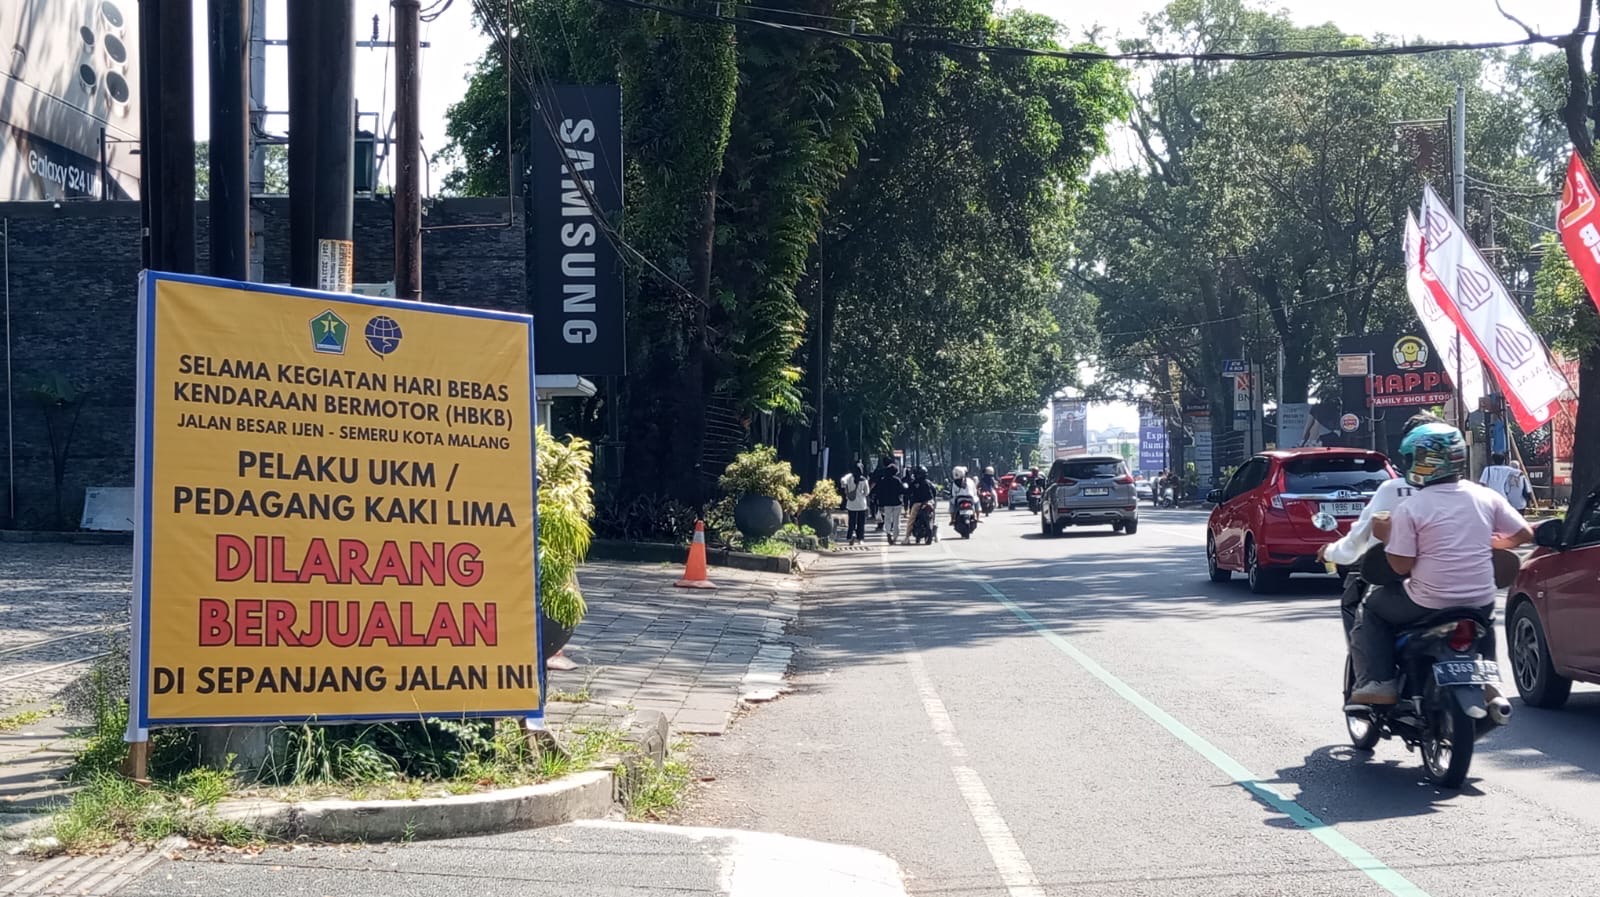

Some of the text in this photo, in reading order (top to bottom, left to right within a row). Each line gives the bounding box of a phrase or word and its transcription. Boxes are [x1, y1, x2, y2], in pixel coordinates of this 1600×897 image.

[28, 150, 67, 191] Galaxy
[68, 165, 85, 192] S24
[560, 118, 598, 344] SAMSUNG
[178, 354, 509, 402] SELAMA KEGIATAN HARI BEBAS
[1238, 393, 1254, 402] BN
[1429, 394, 1453, 402] STOR
[174, 382, 513, 431] KENDARAAN BERMOTOR (HBKB)
[177, 413, 232, 430] JALAN
[237, 418, 287, 435] BESAR
[292, 422, 324, 438] IJEN
[339, 425, 398, 443] SEMERU
[403, 431, 444, 446] KOTA
[448, 435, 510, 450] MALANG
[1146, 431, 1167, 442] Expo
[238, 450, 460, 492] PELAKU UKM /
[174, 487, 516, 527] PEDAGANG KAKI LIMA
[215, 534, 484, 587] DILARANG
[198, 598, 498, 648] BERJUALAN
[153, 665, 533, 694] DI SEPANJANG JALAN INI
